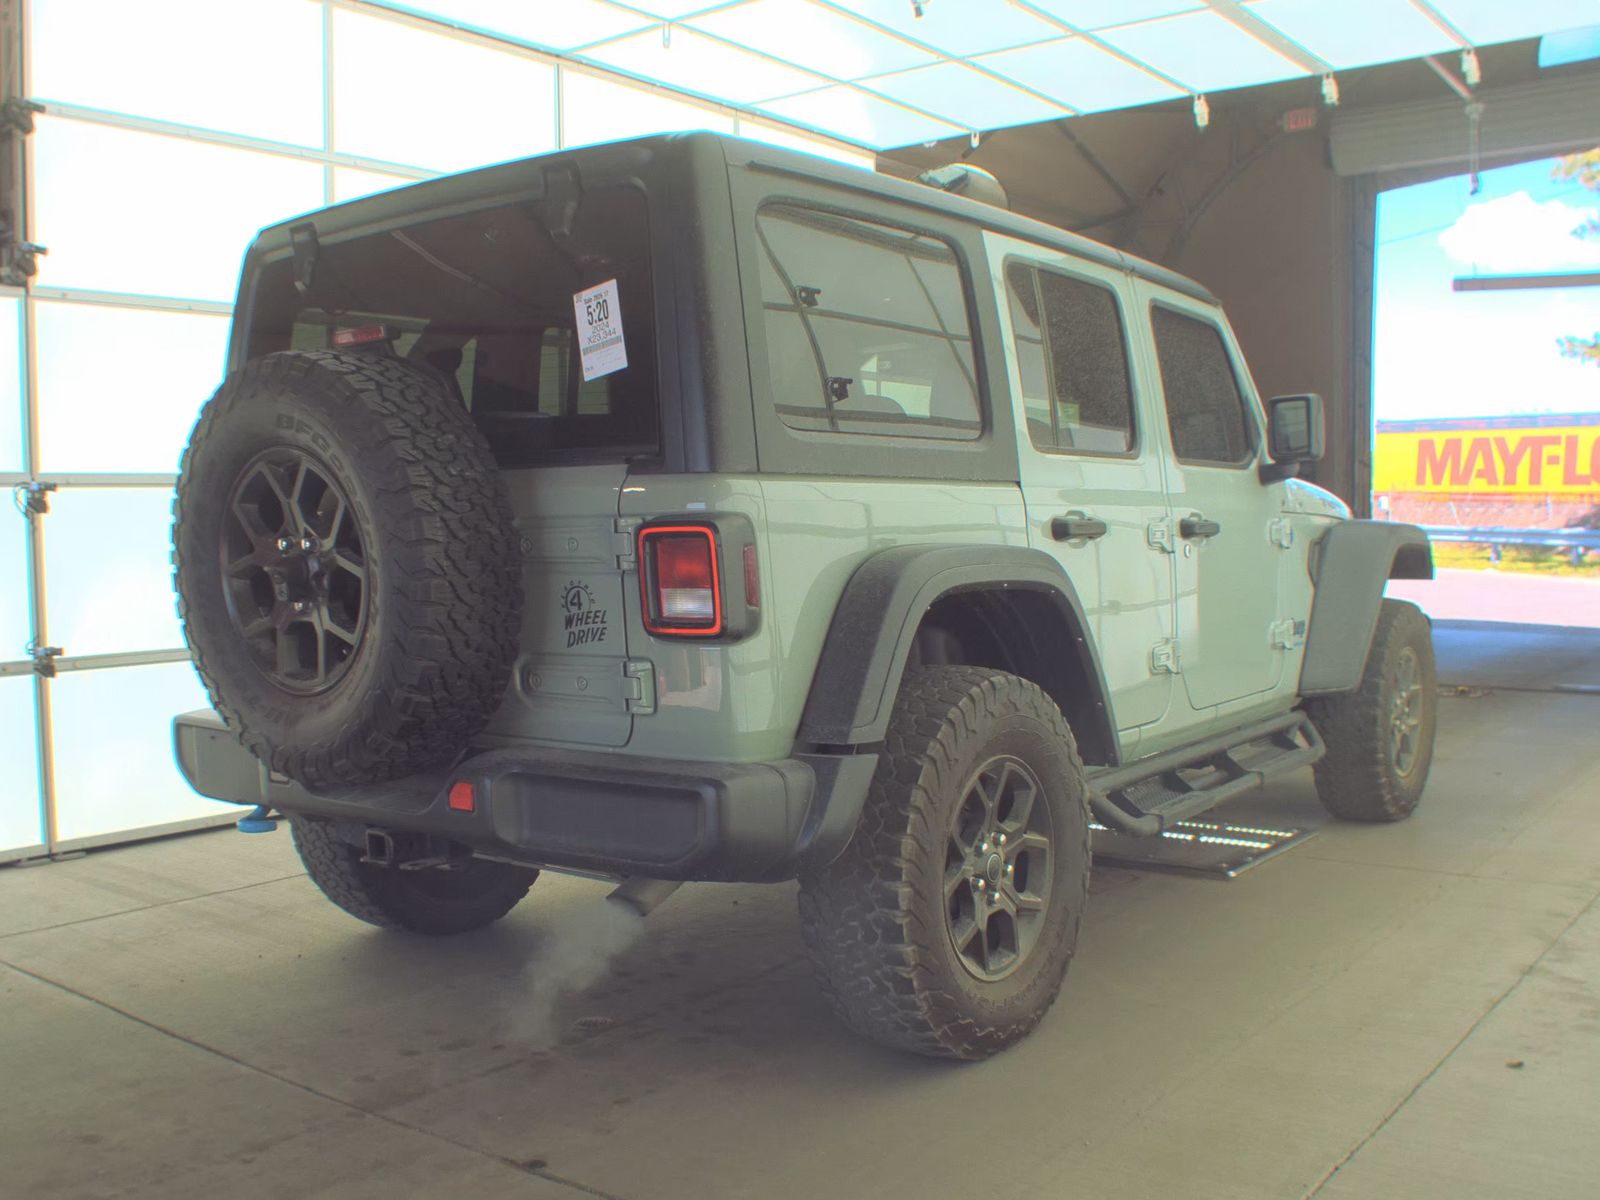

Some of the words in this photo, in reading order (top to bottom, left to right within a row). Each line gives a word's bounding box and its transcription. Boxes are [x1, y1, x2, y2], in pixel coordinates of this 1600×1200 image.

[587, 299, 609, 325] 5:20
[592, 322, 609, 333] 2024
[569, 590, 583, 610] 4
[565, 610, 607, 630] WHEEL
[567, 627, 607, 648] DRIVE
